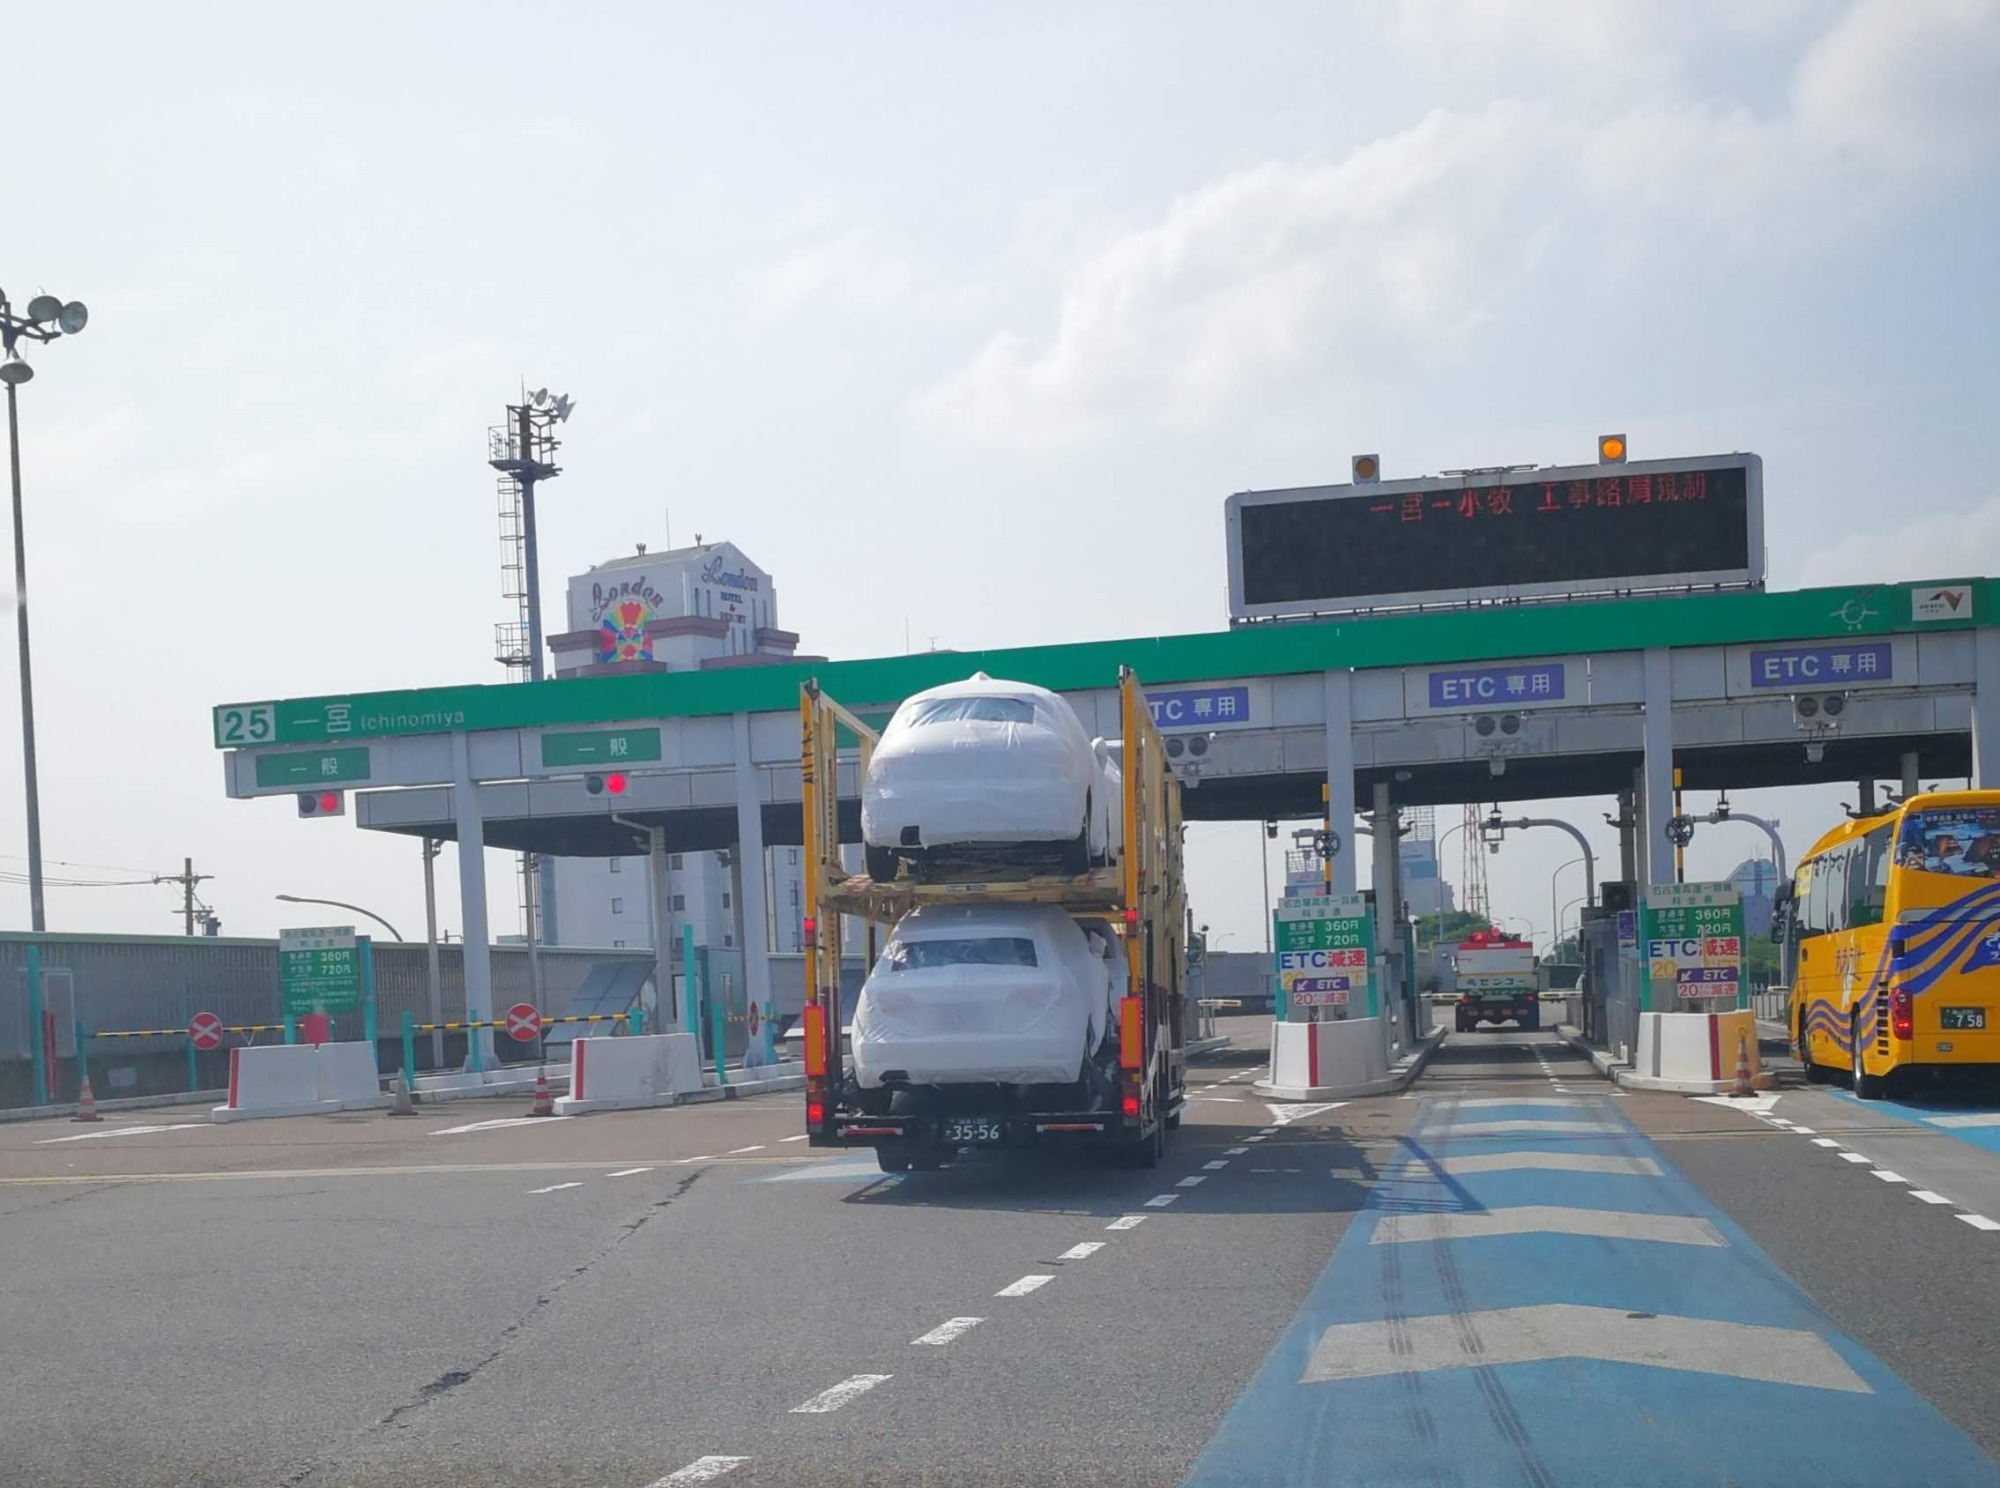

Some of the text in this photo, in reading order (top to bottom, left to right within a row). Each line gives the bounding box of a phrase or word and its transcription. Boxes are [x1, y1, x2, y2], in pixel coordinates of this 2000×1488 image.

[588, 575, 664, 622] London
[1764, 652, 1877, 679] ETC 専用
[1442, 674, 1551, 700] ETC 専用
[1193, 696, 1236, 718] 専用
[224, 709, 271, 741] 25
[293, 703, 352, 734] 一宮
[361, 708, 466, 732] Ichinomiya
[578, 738, 628, 757] 一般
[290, 758, 339, 776] 一般
[1695, 908, 1731, 921] 360円
[1325, 920, 1359, 932] 360円
[1695, 923, 1732, 935] 720円
[1325, 933, 1360, 946] 720円
[321, 964, 352, 975] 720円
[1703, 969, 1730, 981] ETC
[1316, 980, 1341, 991] ETC
[1679, 984, 1699, 997] 20
[1295, 993, 1314, 1006] 20
